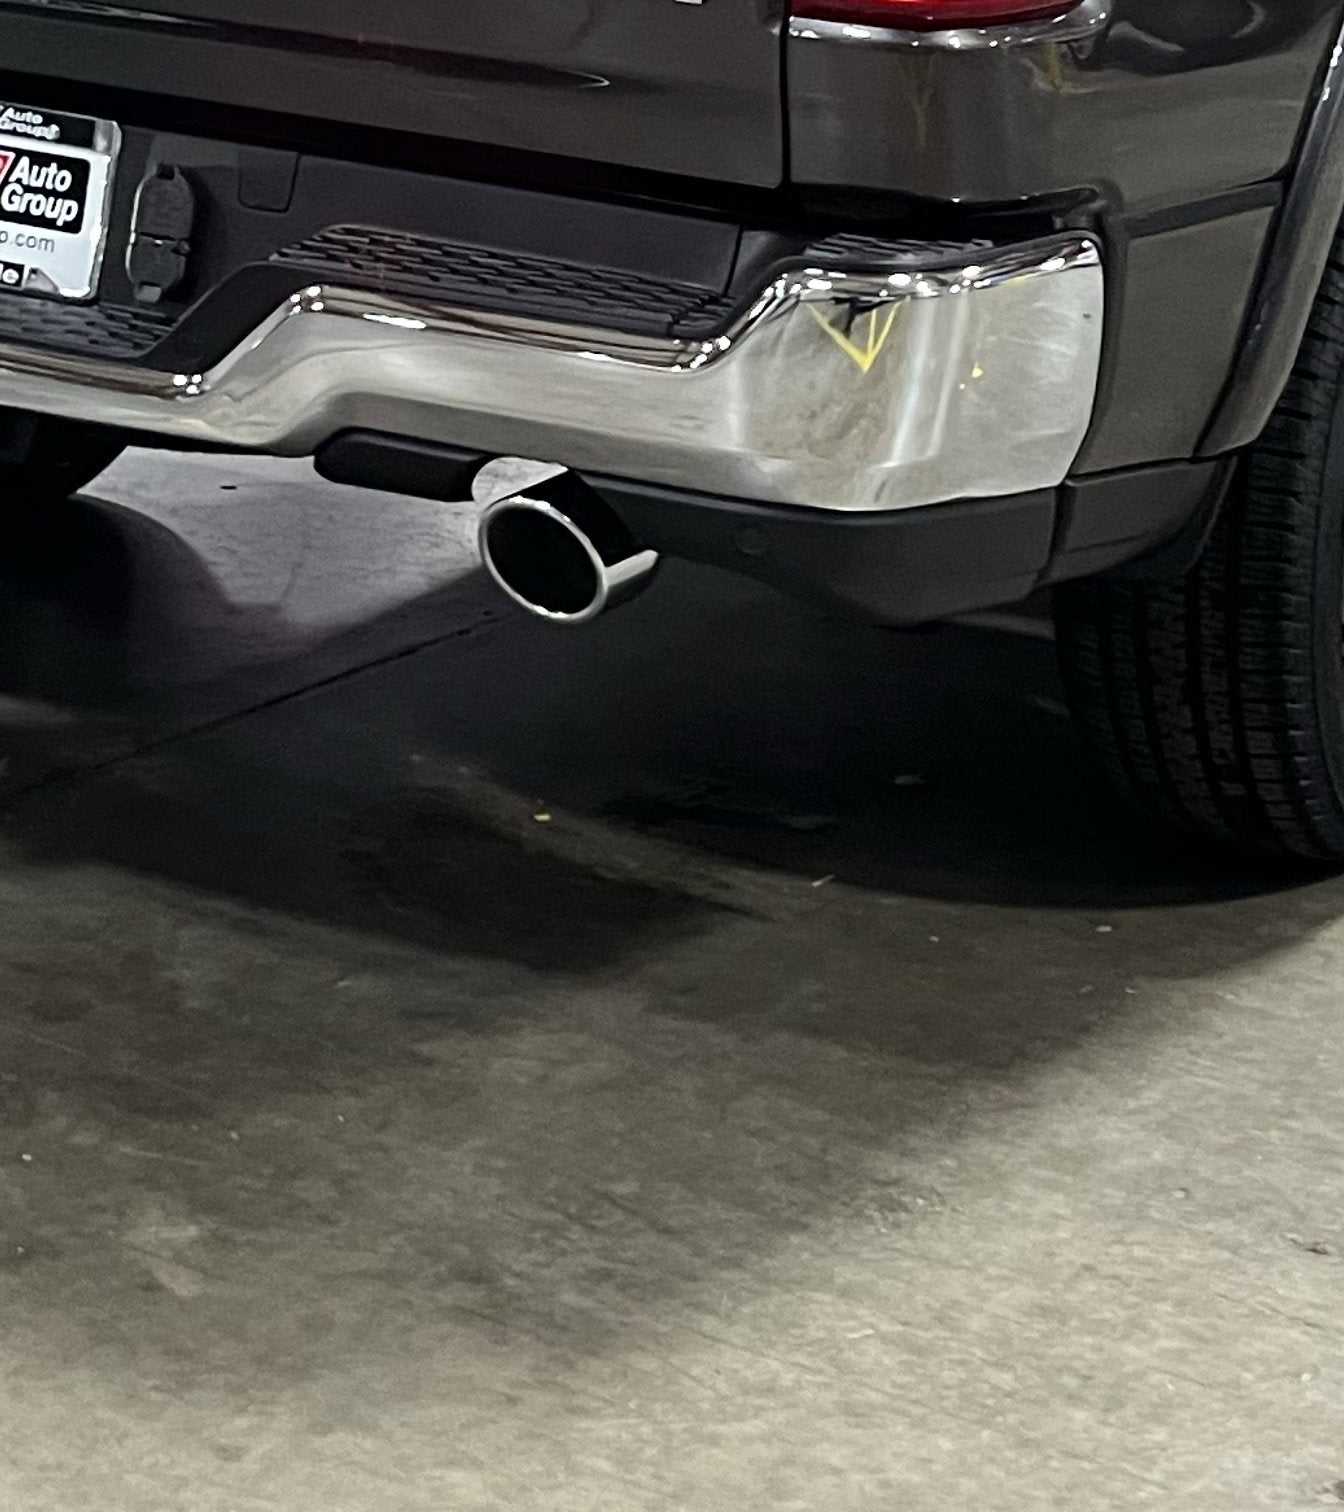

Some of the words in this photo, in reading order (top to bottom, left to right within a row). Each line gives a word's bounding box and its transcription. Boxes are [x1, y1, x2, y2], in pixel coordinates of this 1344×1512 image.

[5, 107, 44, 126] Auto
[8, 155, 73, 191] Auto
[0, 184, 79, 227] Group
